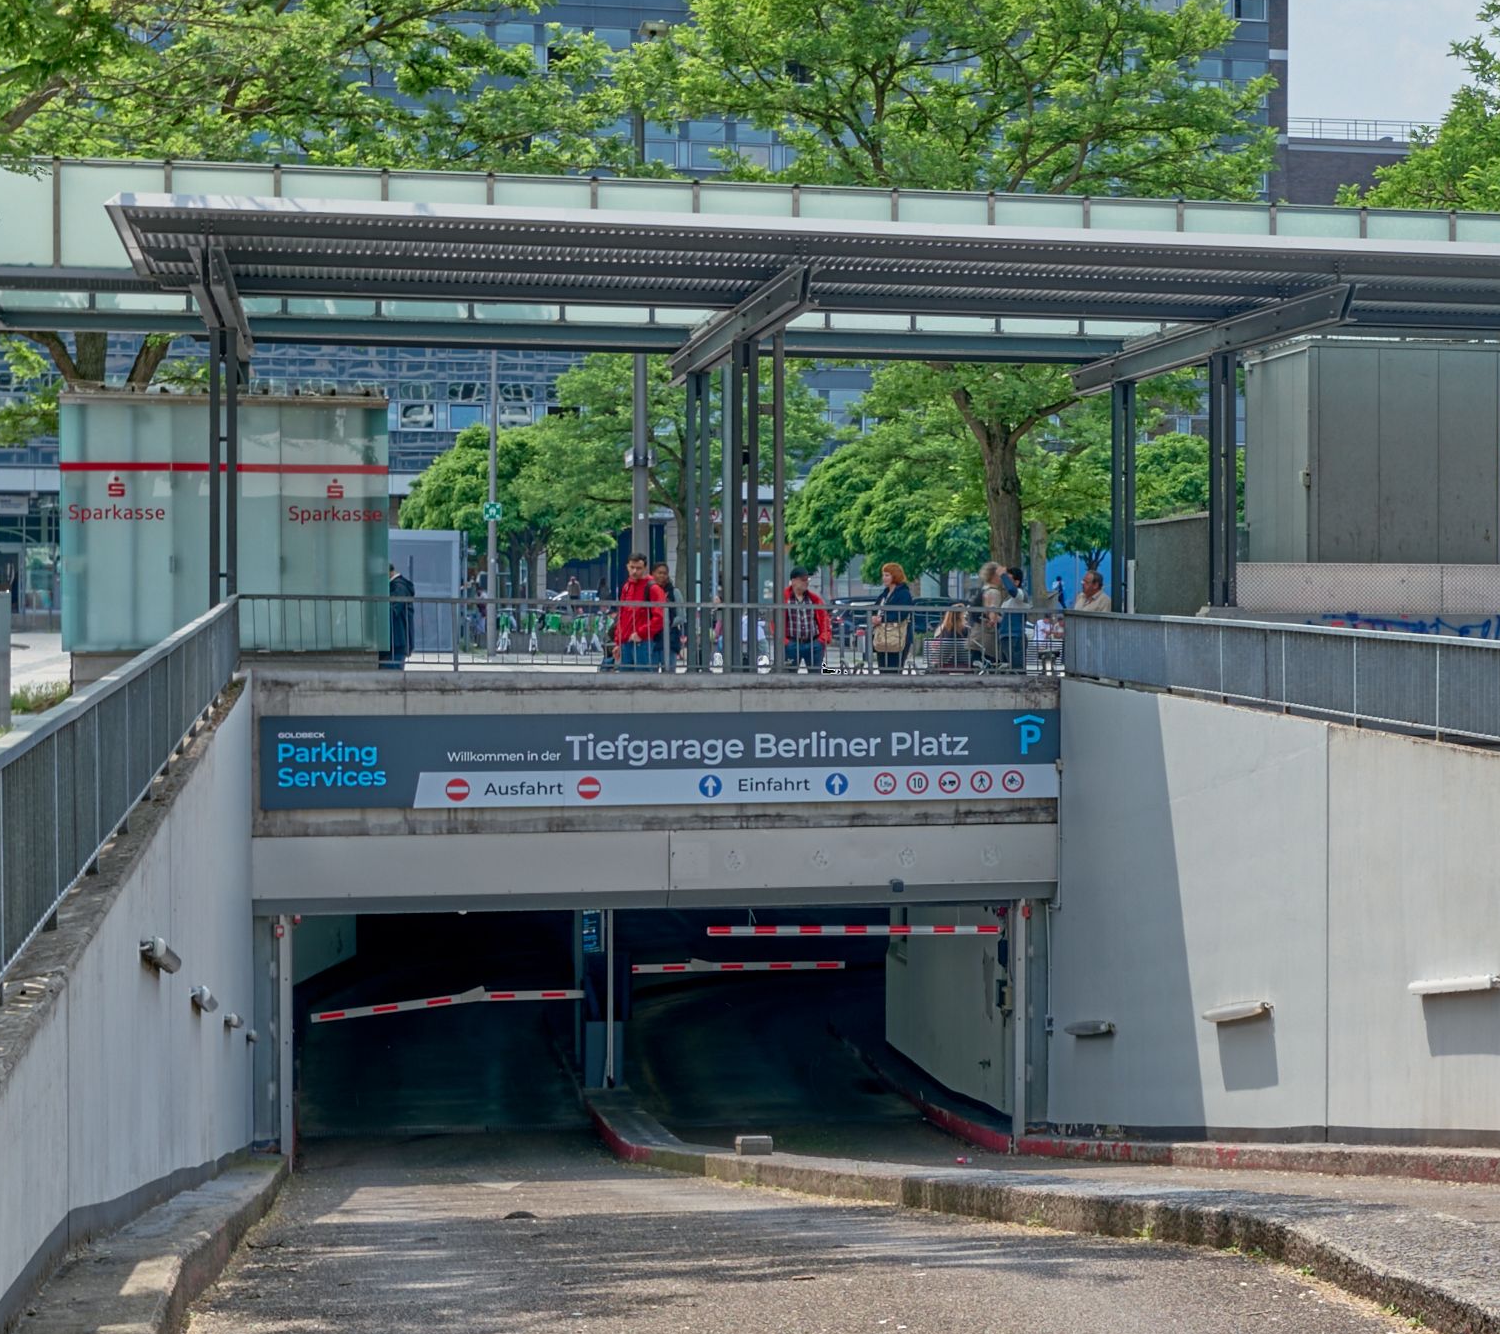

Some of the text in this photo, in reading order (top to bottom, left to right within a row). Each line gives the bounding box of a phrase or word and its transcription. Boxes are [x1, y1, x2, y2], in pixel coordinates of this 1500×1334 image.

[68, 504, 166, 523] Sparkasse
[288, 505, 383, 524] Sparkasse
[447, 730, 969, 766] Willkommen in der Tiefgarage Berliner Platz
[1020, 724, 1041, 755] P
[277, 742, 378, 766] Parking
[277, 766, 387, 788] Services
[738, 777, 811, 793] Einfahrt
[912, 777, 923, 789] 10
[483, 781, 564, 796] Ausfahrt
